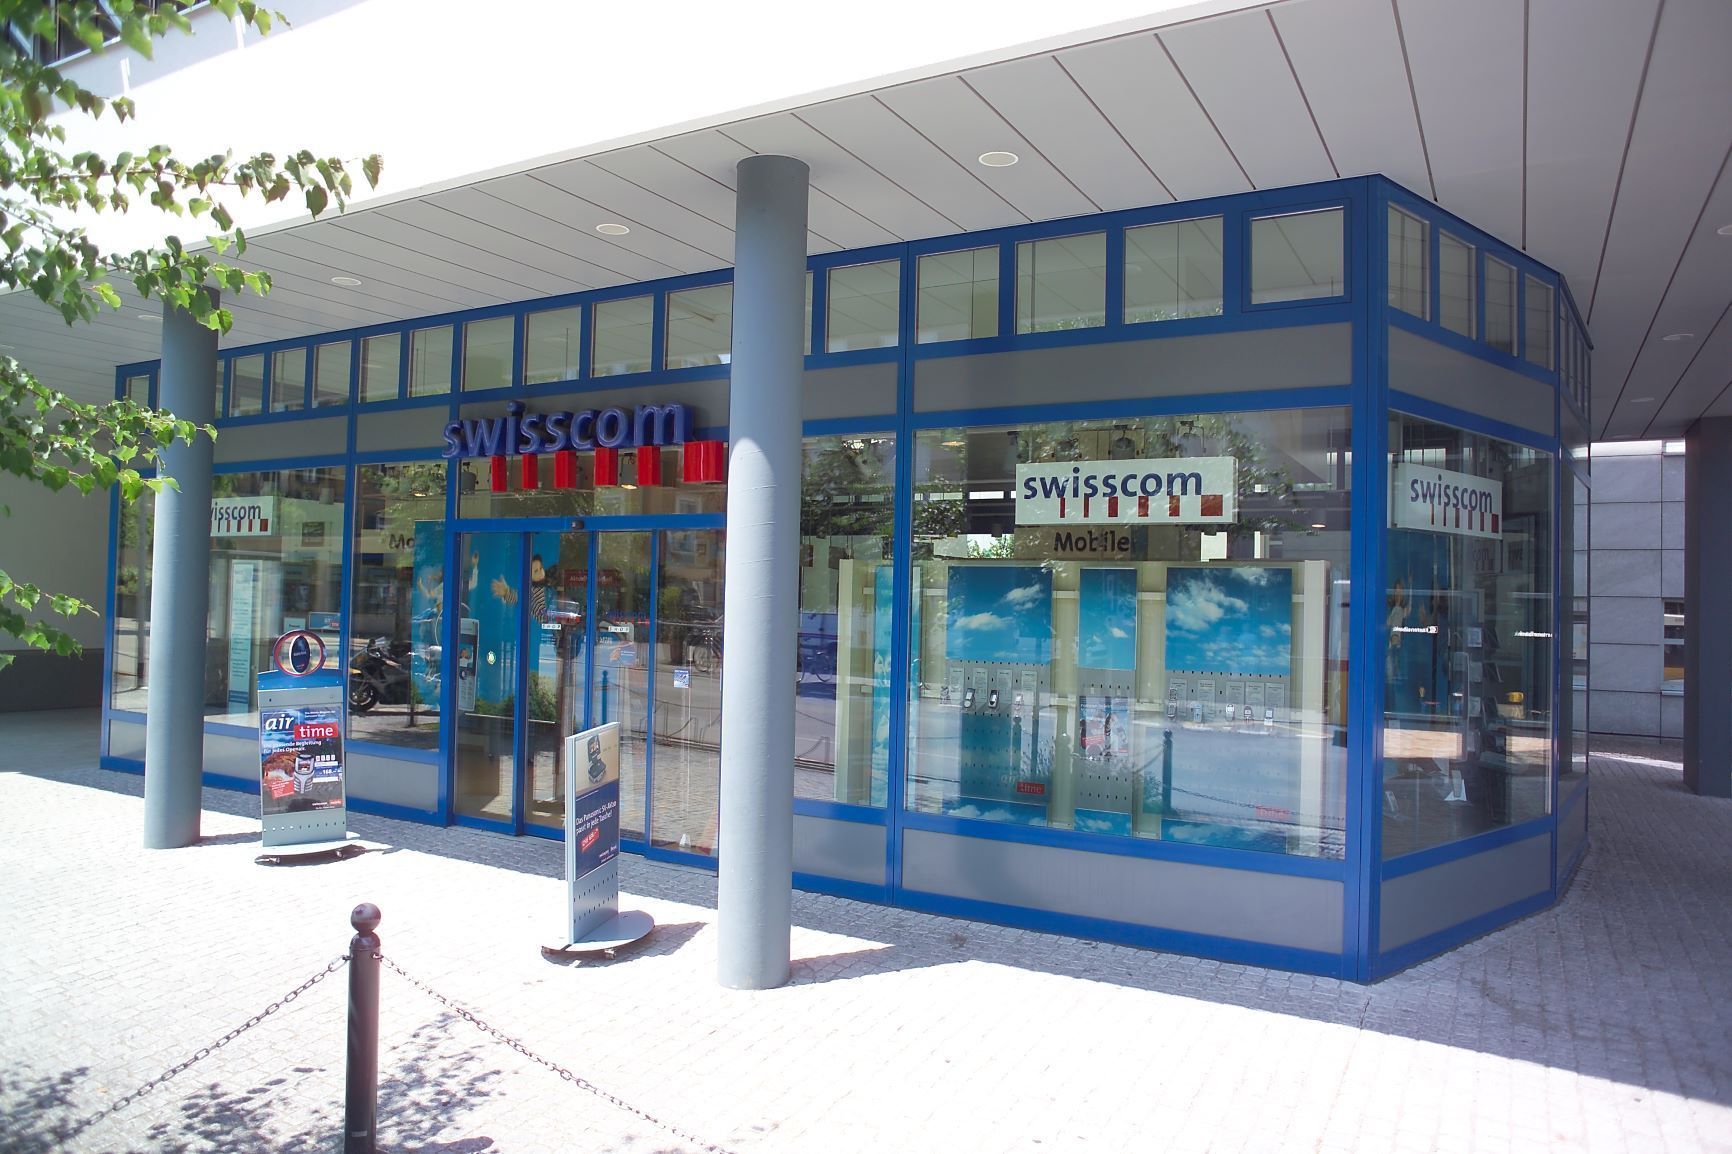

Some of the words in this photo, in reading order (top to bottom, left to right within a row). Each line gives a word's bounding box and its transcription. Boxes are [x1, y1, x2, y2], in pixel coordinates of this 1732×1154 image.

[442, 400, 692, 458] swisscom
[1023, 466, 1202, 499] swisscom
[1410, 473, 1492, 514] swisscom
[1053, 530, 1130, 552] Mobile
[265, 713, 295, 731] air
[300, 725, 334, 738] time
